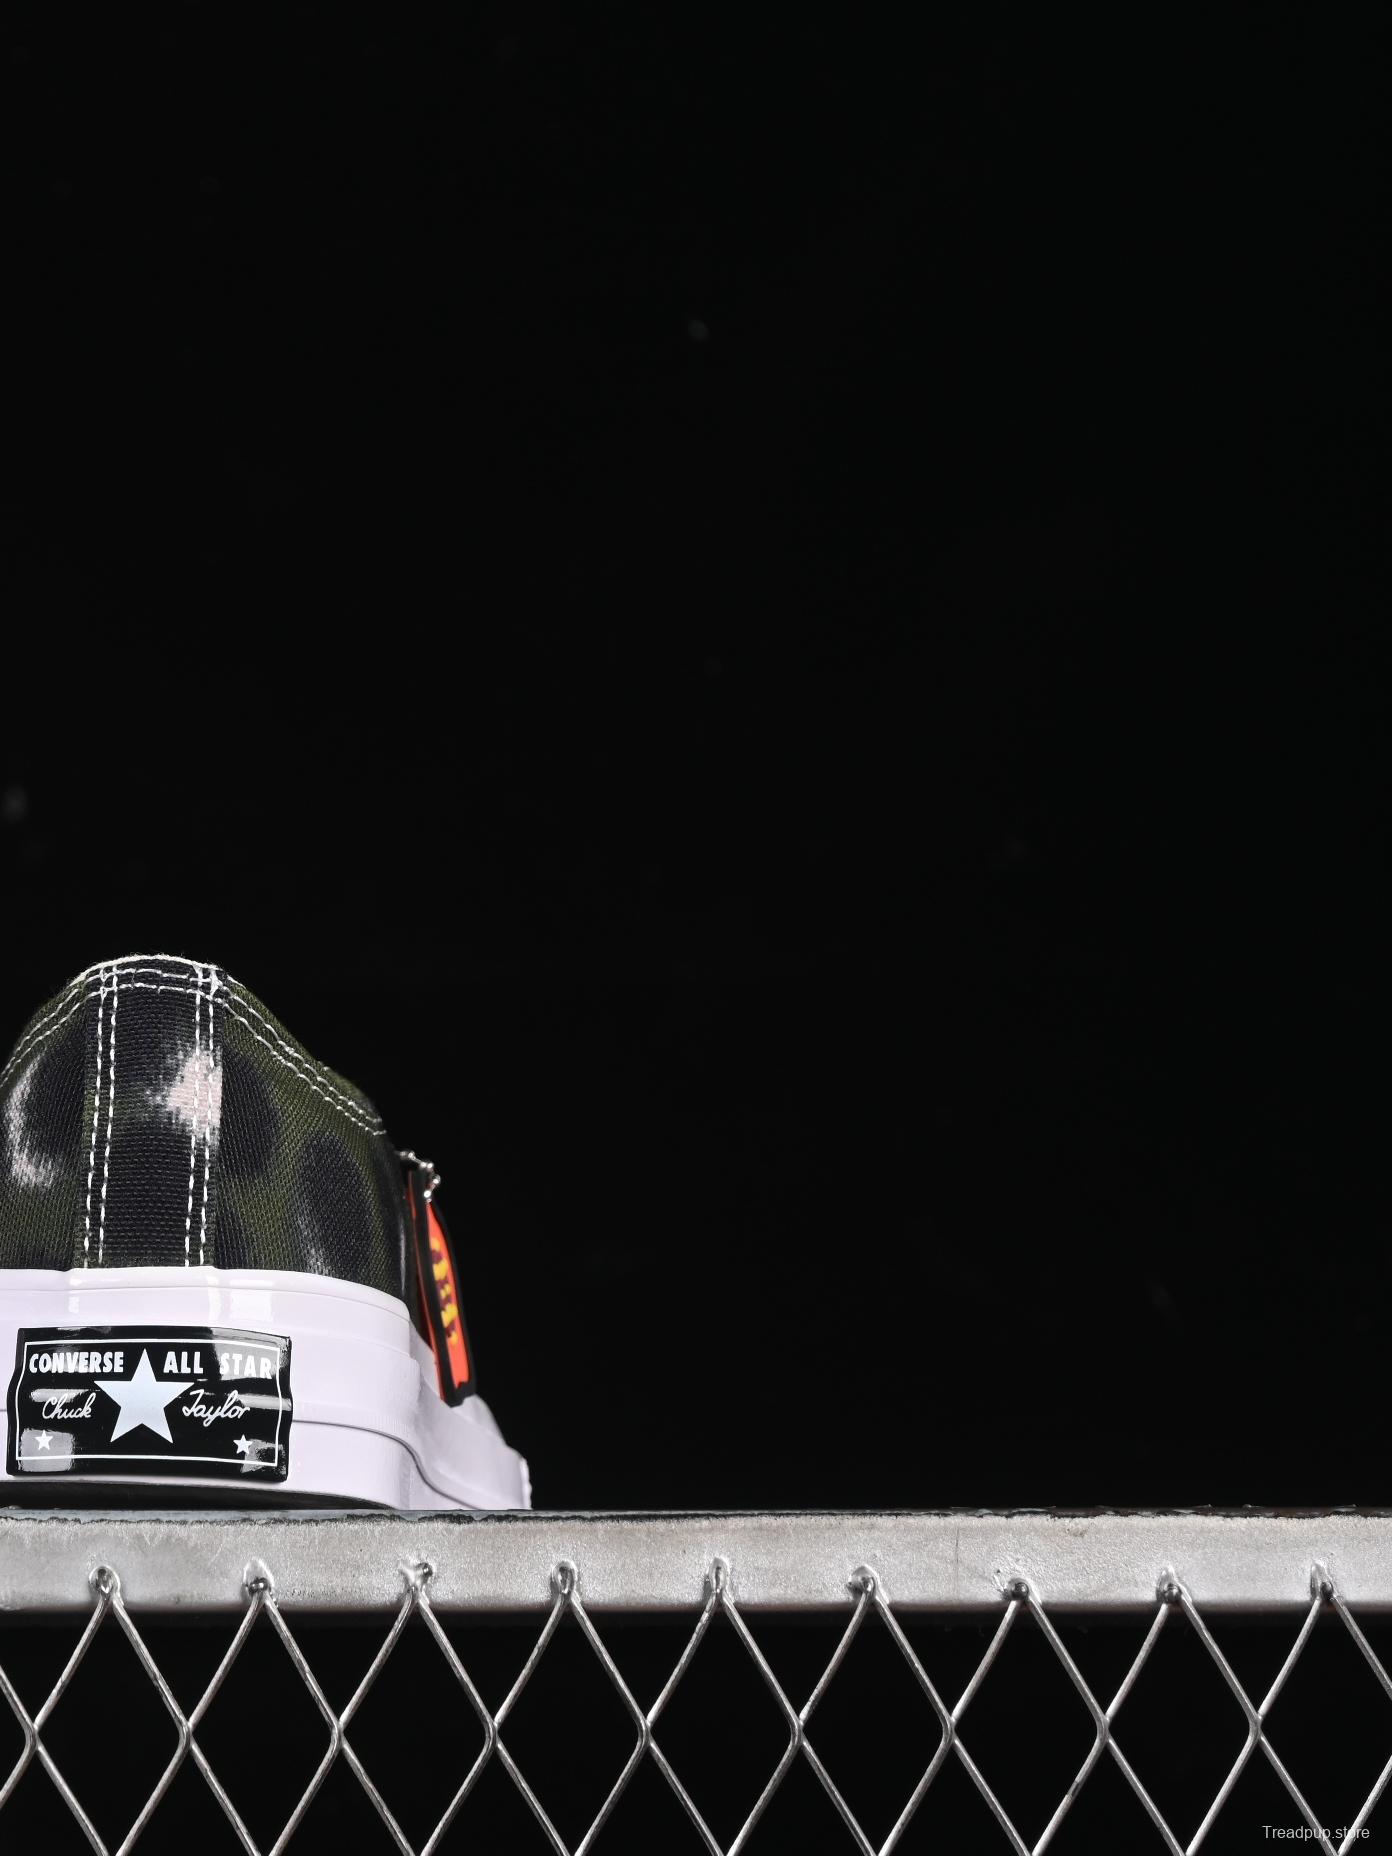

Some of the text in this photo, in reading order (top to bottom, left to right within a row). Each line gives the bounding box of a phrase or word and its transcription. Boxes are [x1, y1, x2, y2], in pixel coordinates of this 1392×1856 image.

[29, 1351, 273, 1379] CONVERSE ALL STAR
[41, 1389, 251, 1428] Chuck Taylor
